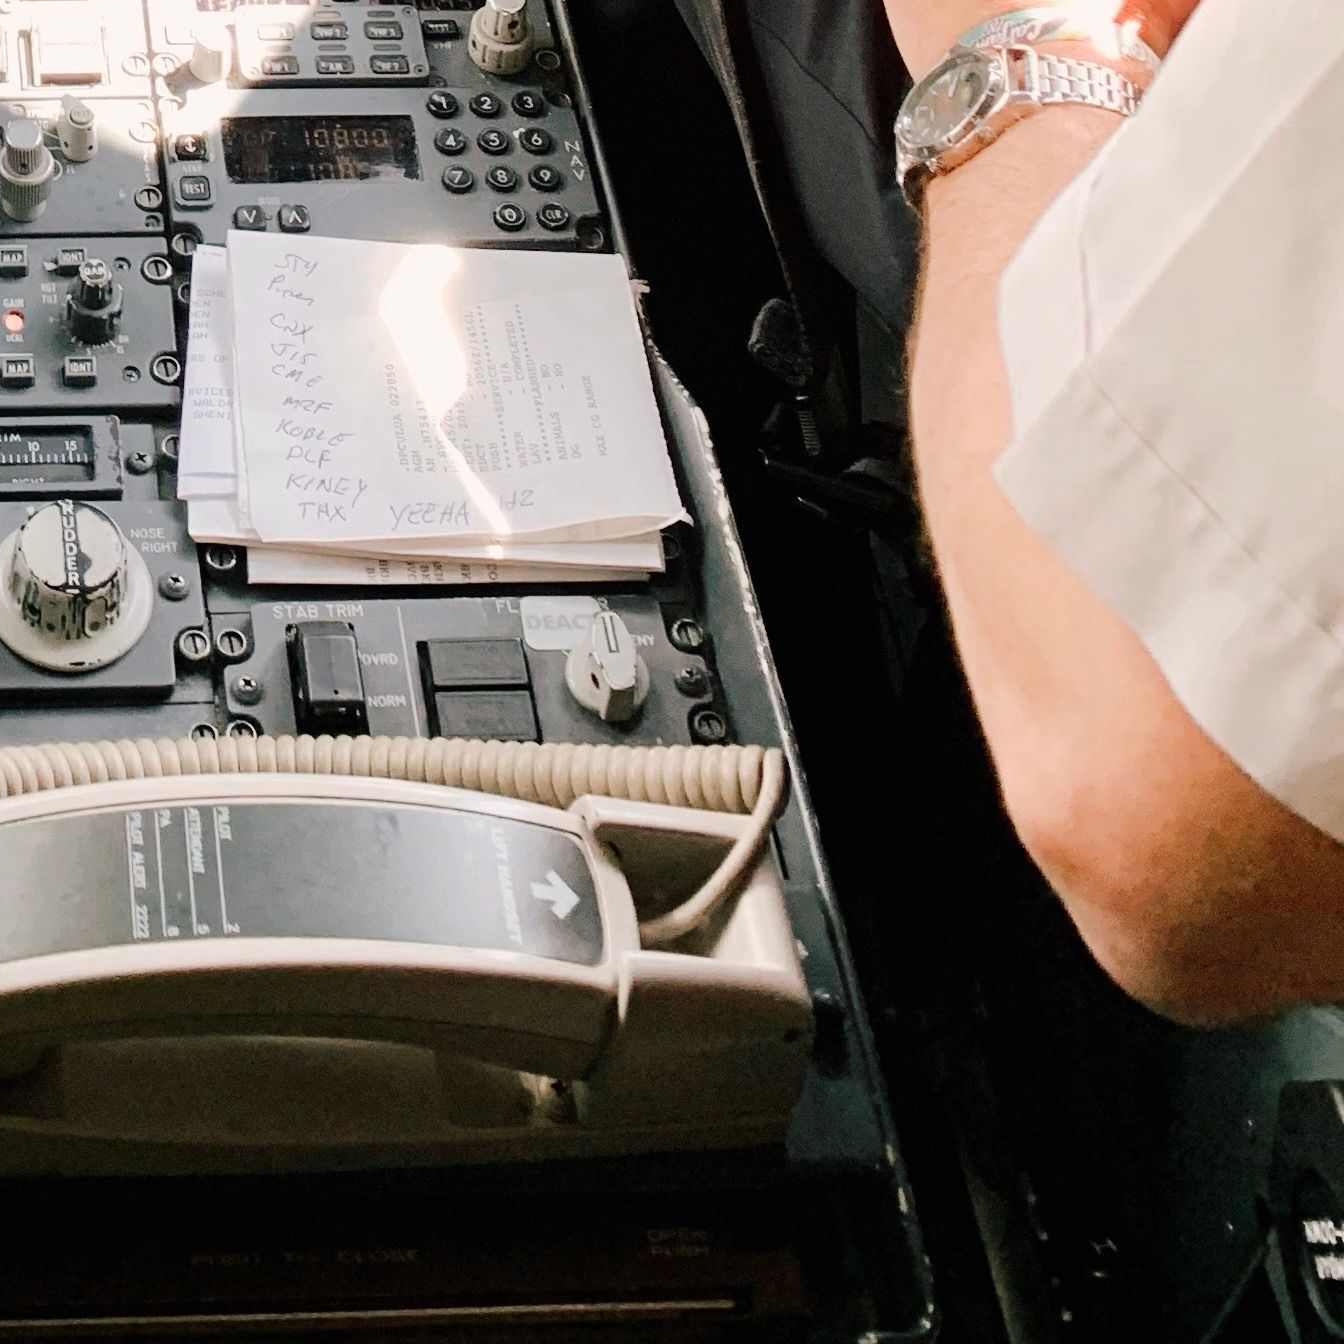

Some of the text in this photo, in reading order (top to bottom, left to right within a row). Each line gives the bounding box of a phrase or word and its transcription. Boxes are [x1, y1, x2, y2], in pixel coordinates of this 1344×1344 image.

[506, 320, 525, 381] COMPLETED
[286, 446, 333, 469] DLF
[286, 472, 368, 507] KINEY
[390, 501, 470, 531] YEEHA
[59, 498, 80, 586] RUDDER
[130, 528, 165, 539] NOSE
[141, 542, 178, 554] RIGHT
[273, 604, 364, 620] STAB TRIM
[368, 695, 407, 708] NORM
[218, 806, 232, 840] PILOT
[189, 807, 204, 874] ATTENDANT
